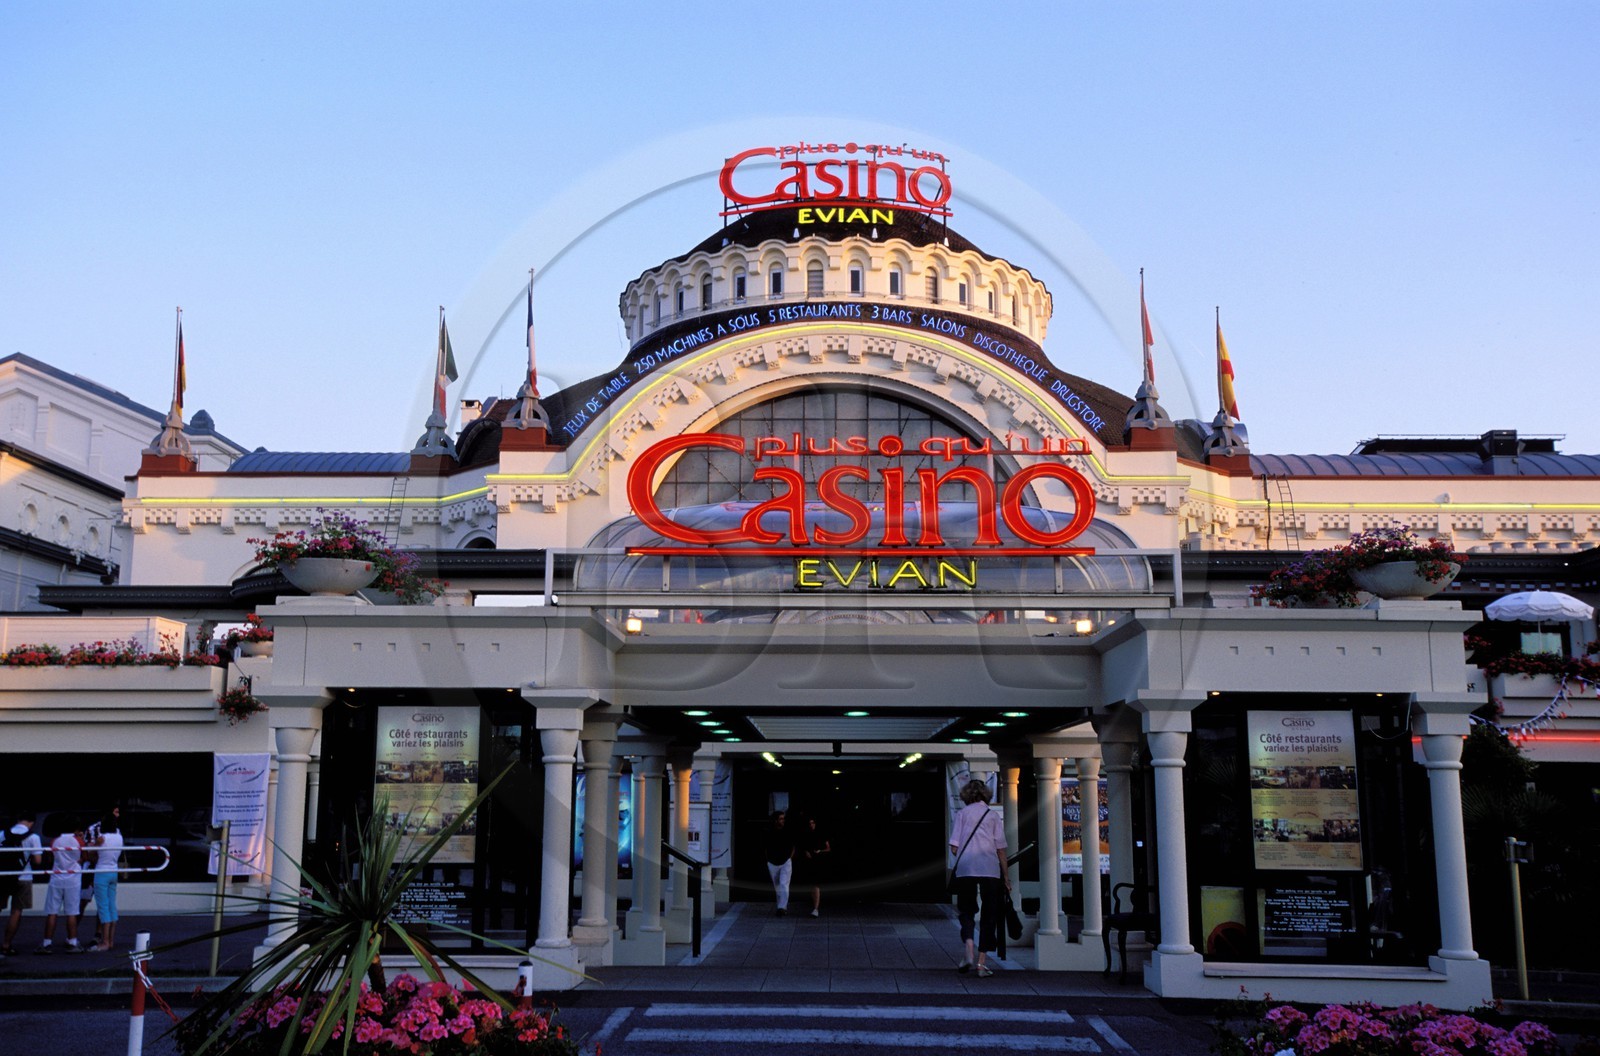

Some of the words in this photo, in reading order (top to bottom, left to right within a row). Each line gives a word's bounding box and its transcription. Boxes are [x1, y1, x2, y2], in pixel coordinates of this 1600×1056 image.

[779, 141, 839, 159] plus
[719, 146, 952, 208] Casino
[798, 208, 894, 225] EVIAN
[563, 410, 589, 438] JEUX
[585, 396, 602, 414] DE
[598, 372, 631, 401] TABLE
[633, 355, 656, 375] 250
[655, 327, 714, 363] MACHINES
[716, 324, 727, 336] A
[728, 313, 761, 332] SOUS
[769, 310, 777, 323] 5
[779, 304, 861, 321] RESTAURANTS
[871, 305, 879, 319] 3
[882, 307, 912, 324] BARS
[921, 314, 967, 338] SALONS
[973, 332, 1049, 382] DISCOTHEQUE
[1050, 379, 1106, 434] DRUGSTORE
[753, 432, 868, 461] plus
[627, 433, 1097, 546] Casino
[795, 556, 977, 588] EVIAN
[412, 713, 445, 723] Casino
[1281, 717, 1316, 727] Casino
[389, 729, 411, 739] Côté
[414, 730, 468, 739] restaurants
[1260, 733, 1282, 743] Côté
[1285, 734, 1342, 743] restaurants
[391, 739, 417, 748] variez
[419, 739, 432, 748] les
[433, 739, 465, 749] plaisirs
[1264, 744, 1289, 753] variez
[1292, 744, 1305, 753] les
[1307, 744, 1339, 754] plaisirs
